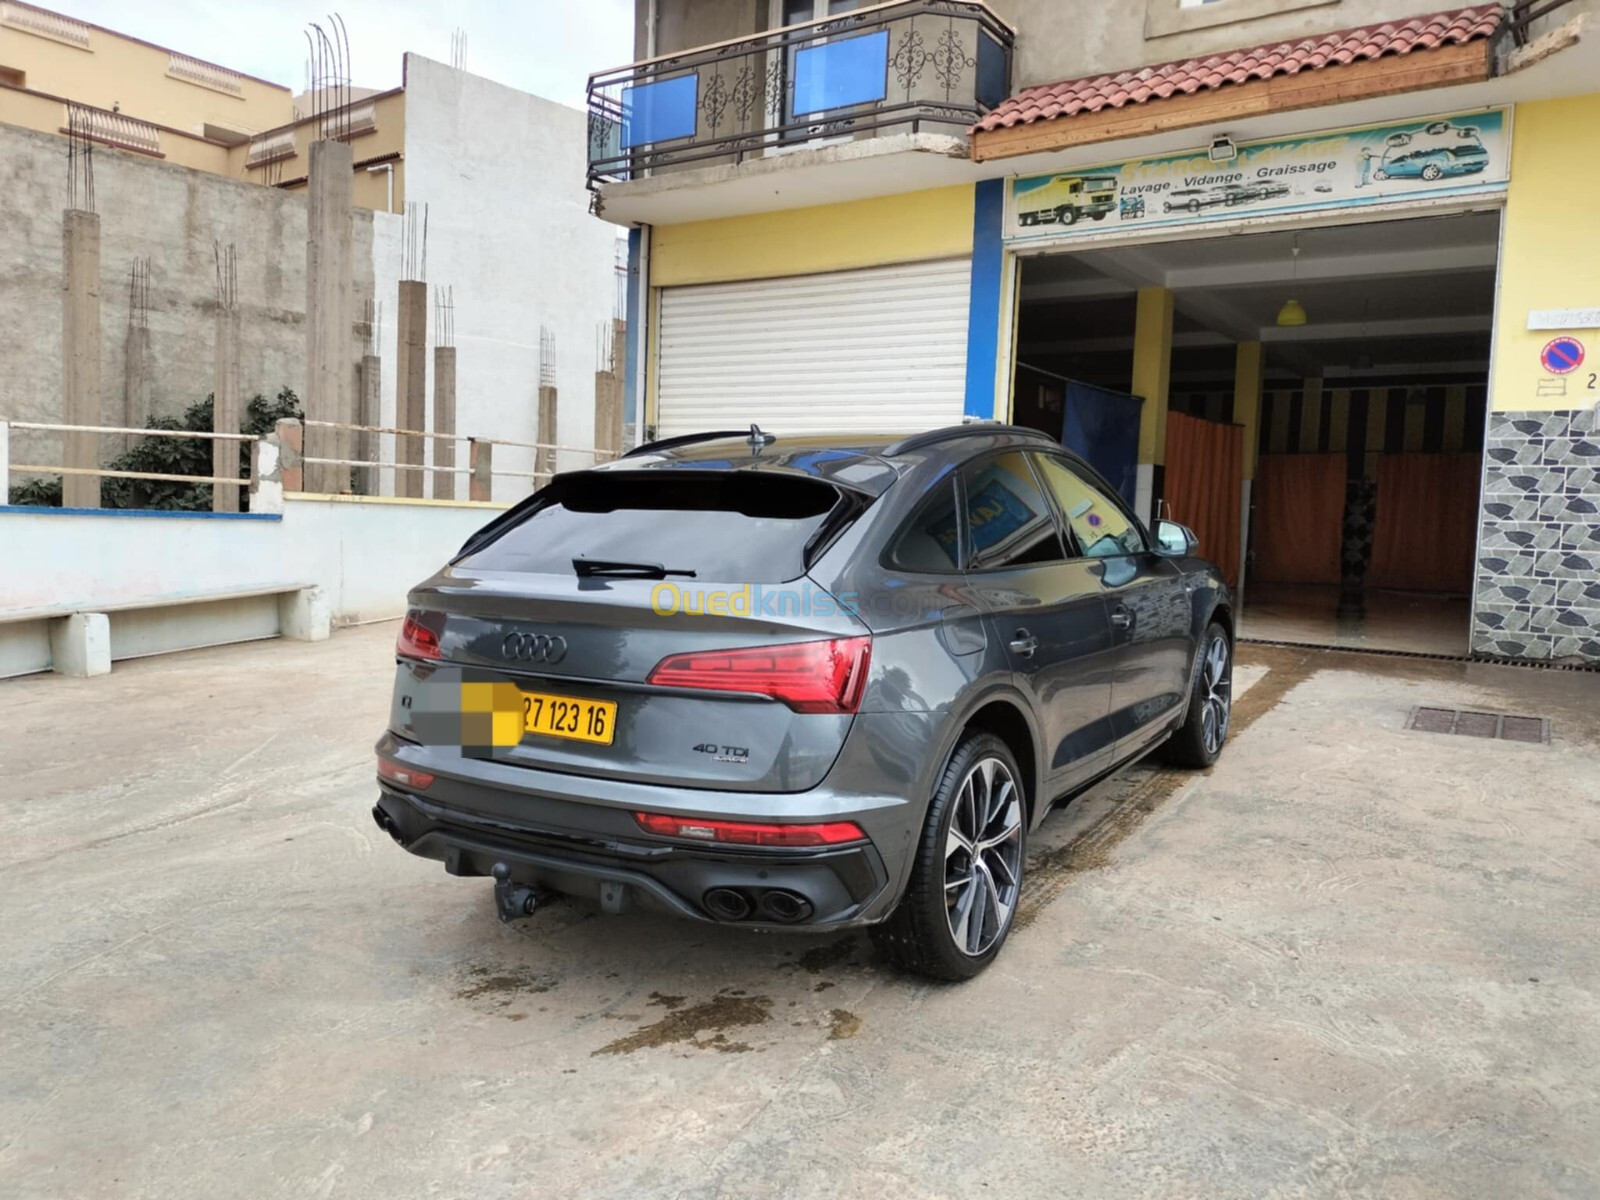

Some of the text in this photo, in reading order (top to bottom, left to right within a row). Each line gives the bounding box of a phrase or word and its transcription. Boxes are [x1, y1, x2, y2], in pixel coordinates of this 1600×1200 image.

[1119, 156, 1338, 197] Lavage Vidange Graissage
[549, 700, 581, 733] 123
[587, 705, 607, 737] 16
[692, 743, 750, 759] 40 TDI
